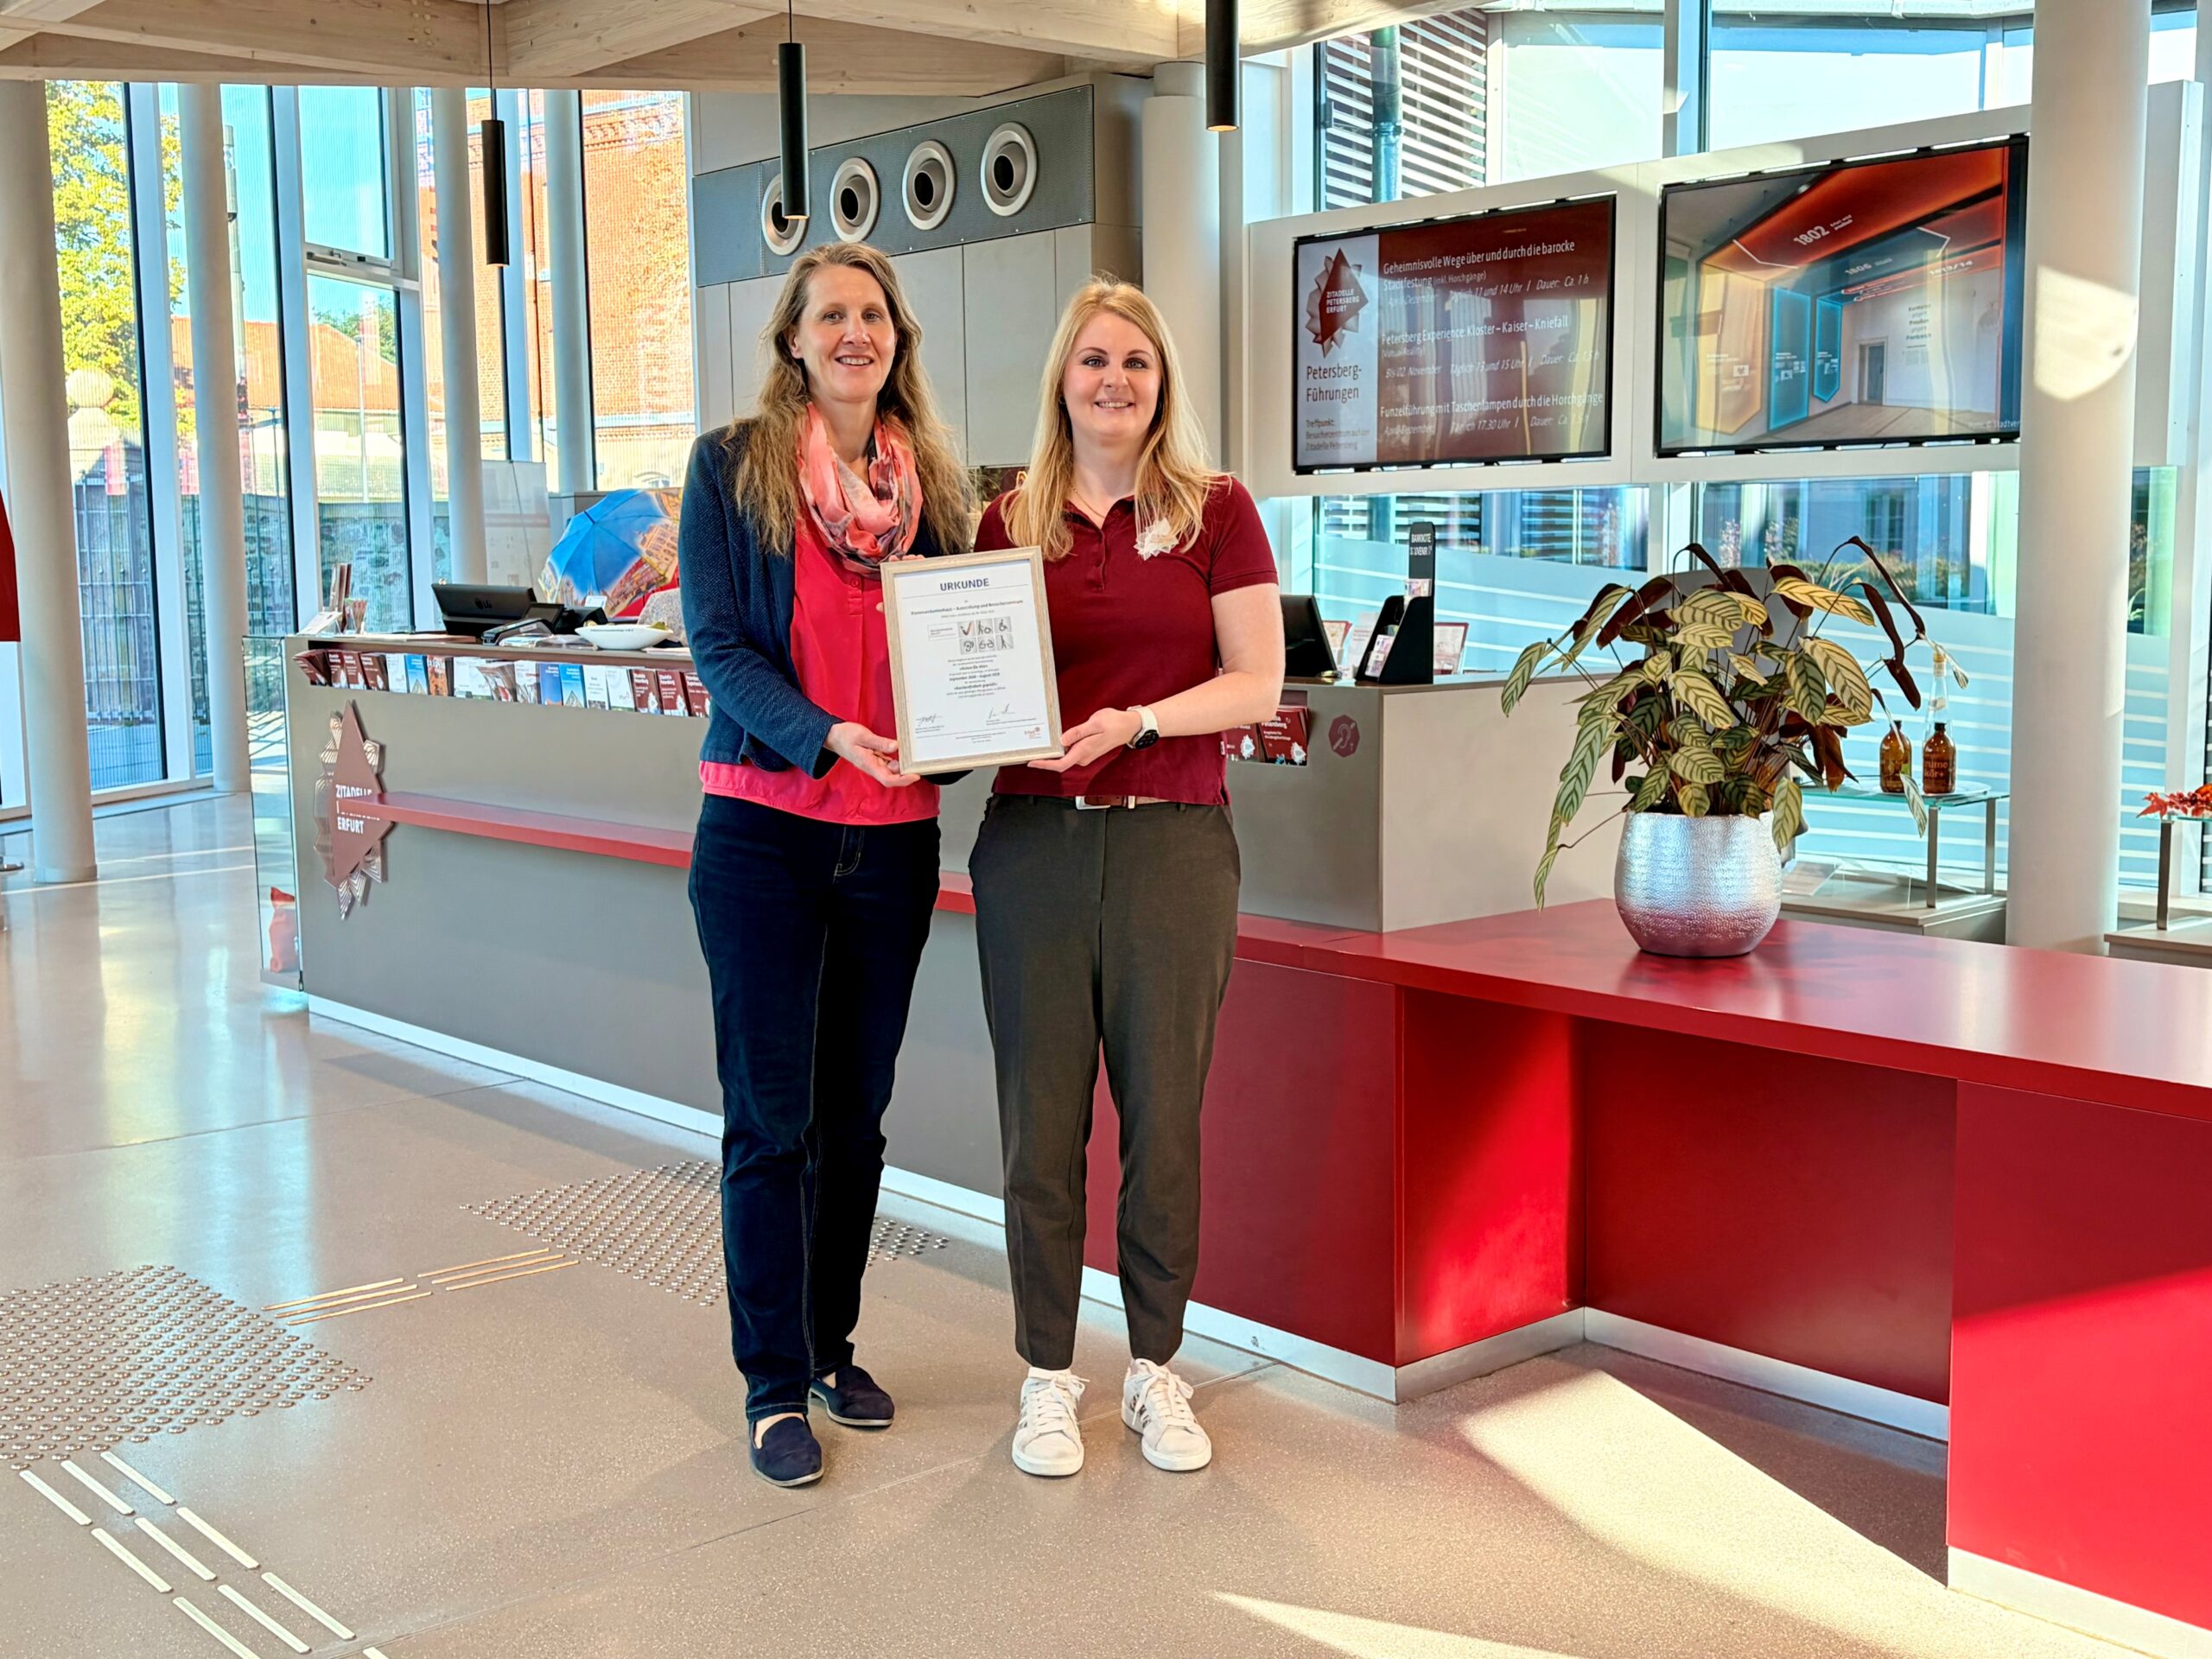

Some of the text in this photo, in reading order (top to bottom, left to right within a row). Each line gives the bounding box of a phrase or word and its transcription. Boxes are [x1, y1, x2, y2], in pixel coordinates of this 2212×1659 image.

[1793, 226, 1830, 245] 1802
[1383, 239, 1575, 275] Geheimnisvolle Wege über und durch die barocke
[1383, 276, 1433, 291] Stadtfestung
[1509, 283, 1522, 294] Uhr
[1326, 289, 1355, 298] ZITADELLE
[1326, 296, 1360, 306] PETERSBERG
[1326, 305, 1347, 314] ERFURT
[1382, 331, 1422, 345] Petersberg
[1467, 324, 1495, 337] Kloster
[1502, 321, 1528, 334] Kaiser
[1535, 315, 1568, 330] Kniefall
[1306, 363, 1362, 380] Petersberg-
[1306, 387, 1359, 404] Führungen
[1380, 391, 1604, 417] Funzelführung mit Taschenlampen durch die Horchgänge
[1497, 419, 1511, 429] Uhr
[939, 578, 990, 592] URKUNDE
[337, 816, 364, 835] ERFURT
